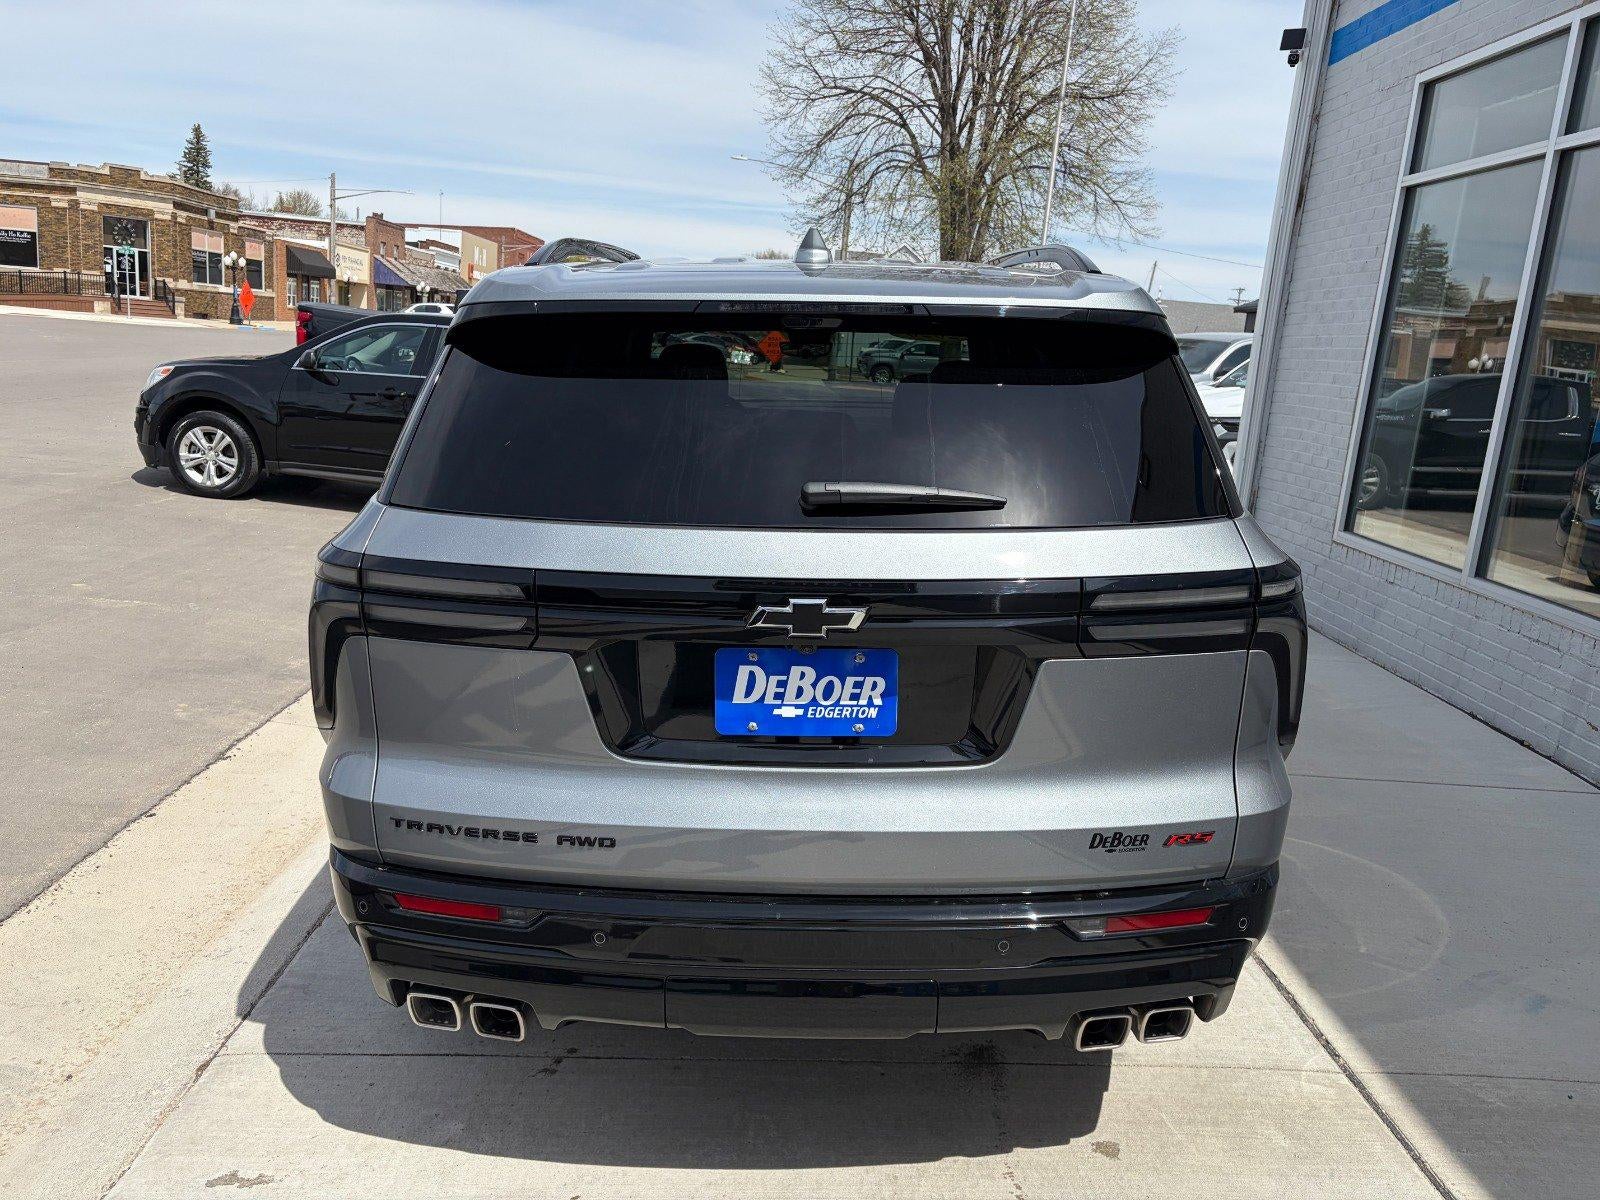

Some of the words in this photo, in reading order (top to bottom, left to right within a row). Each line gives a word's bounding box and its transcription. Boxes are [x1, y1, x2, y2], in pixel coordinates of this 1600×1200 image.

[732, 665, 887, 706] DEBOER
[807, 706, 878, 719] EDGERTON
[389, 816, 539, 844] TRAVERSE
[556, 834, 617, 849] AWD
[1088, 831, 1150, 849] DEBOER
[1161, 830, 1216, 848] RS
